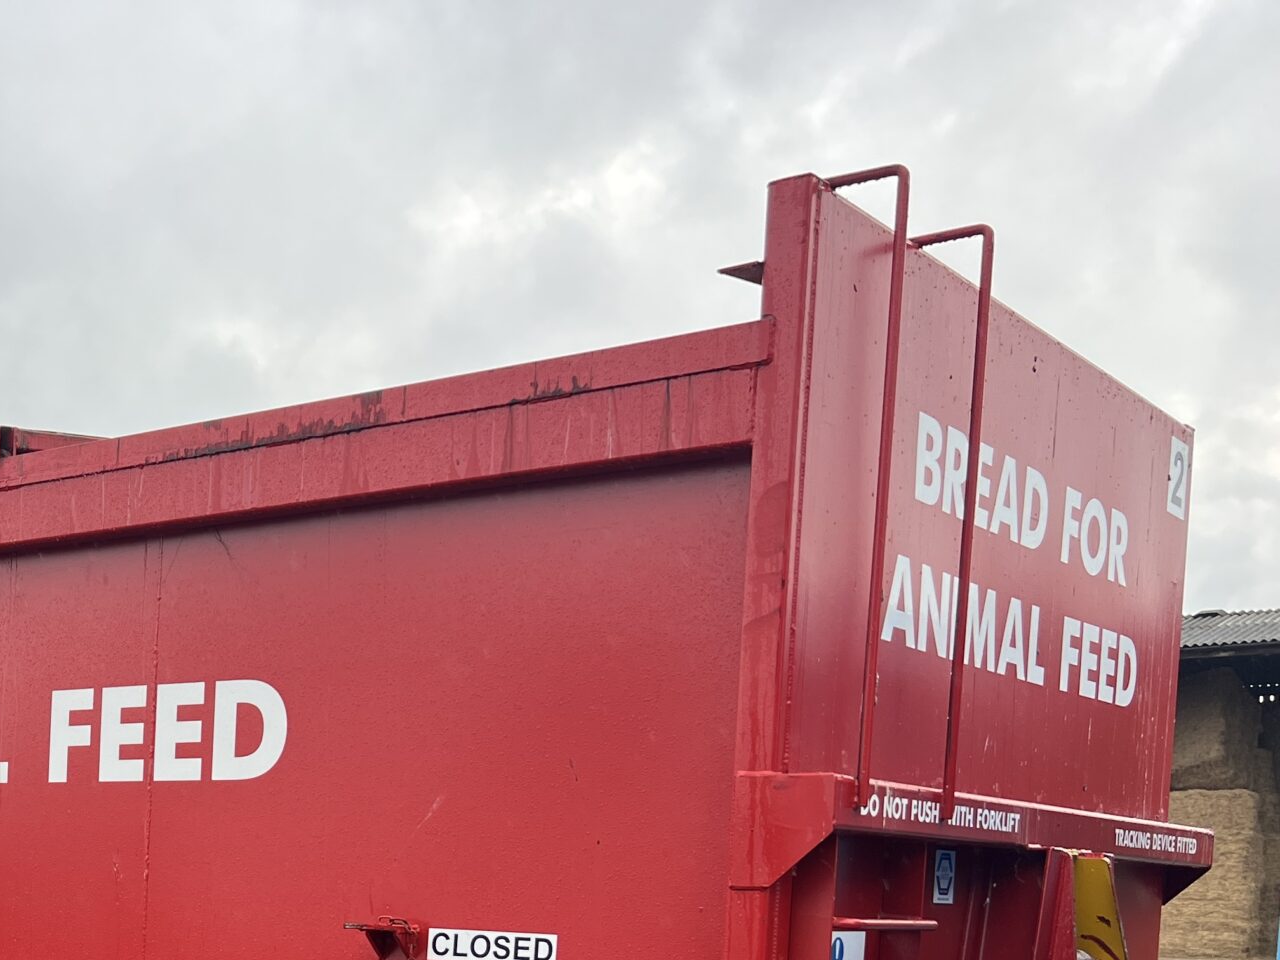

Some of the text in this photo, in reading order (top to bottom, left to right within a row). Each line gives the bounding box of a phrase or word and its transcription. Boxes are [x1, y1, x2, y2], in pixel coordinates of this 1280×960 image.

[915, 411, 1129, 588] BREAD FOR
[1170, 452, 1185, 508] 2
[880, 554, 1138, 707] ANIMAL FEED
[48, 679, 288, 783] FEED
[883, 796, 909, 820] NOT
[911, 799, 940, 824] PUSH
[976, 808, 1020, 833] FORKLIFT
[1115, 828, 1198, 855] TRACKING DEVICE FITTED
